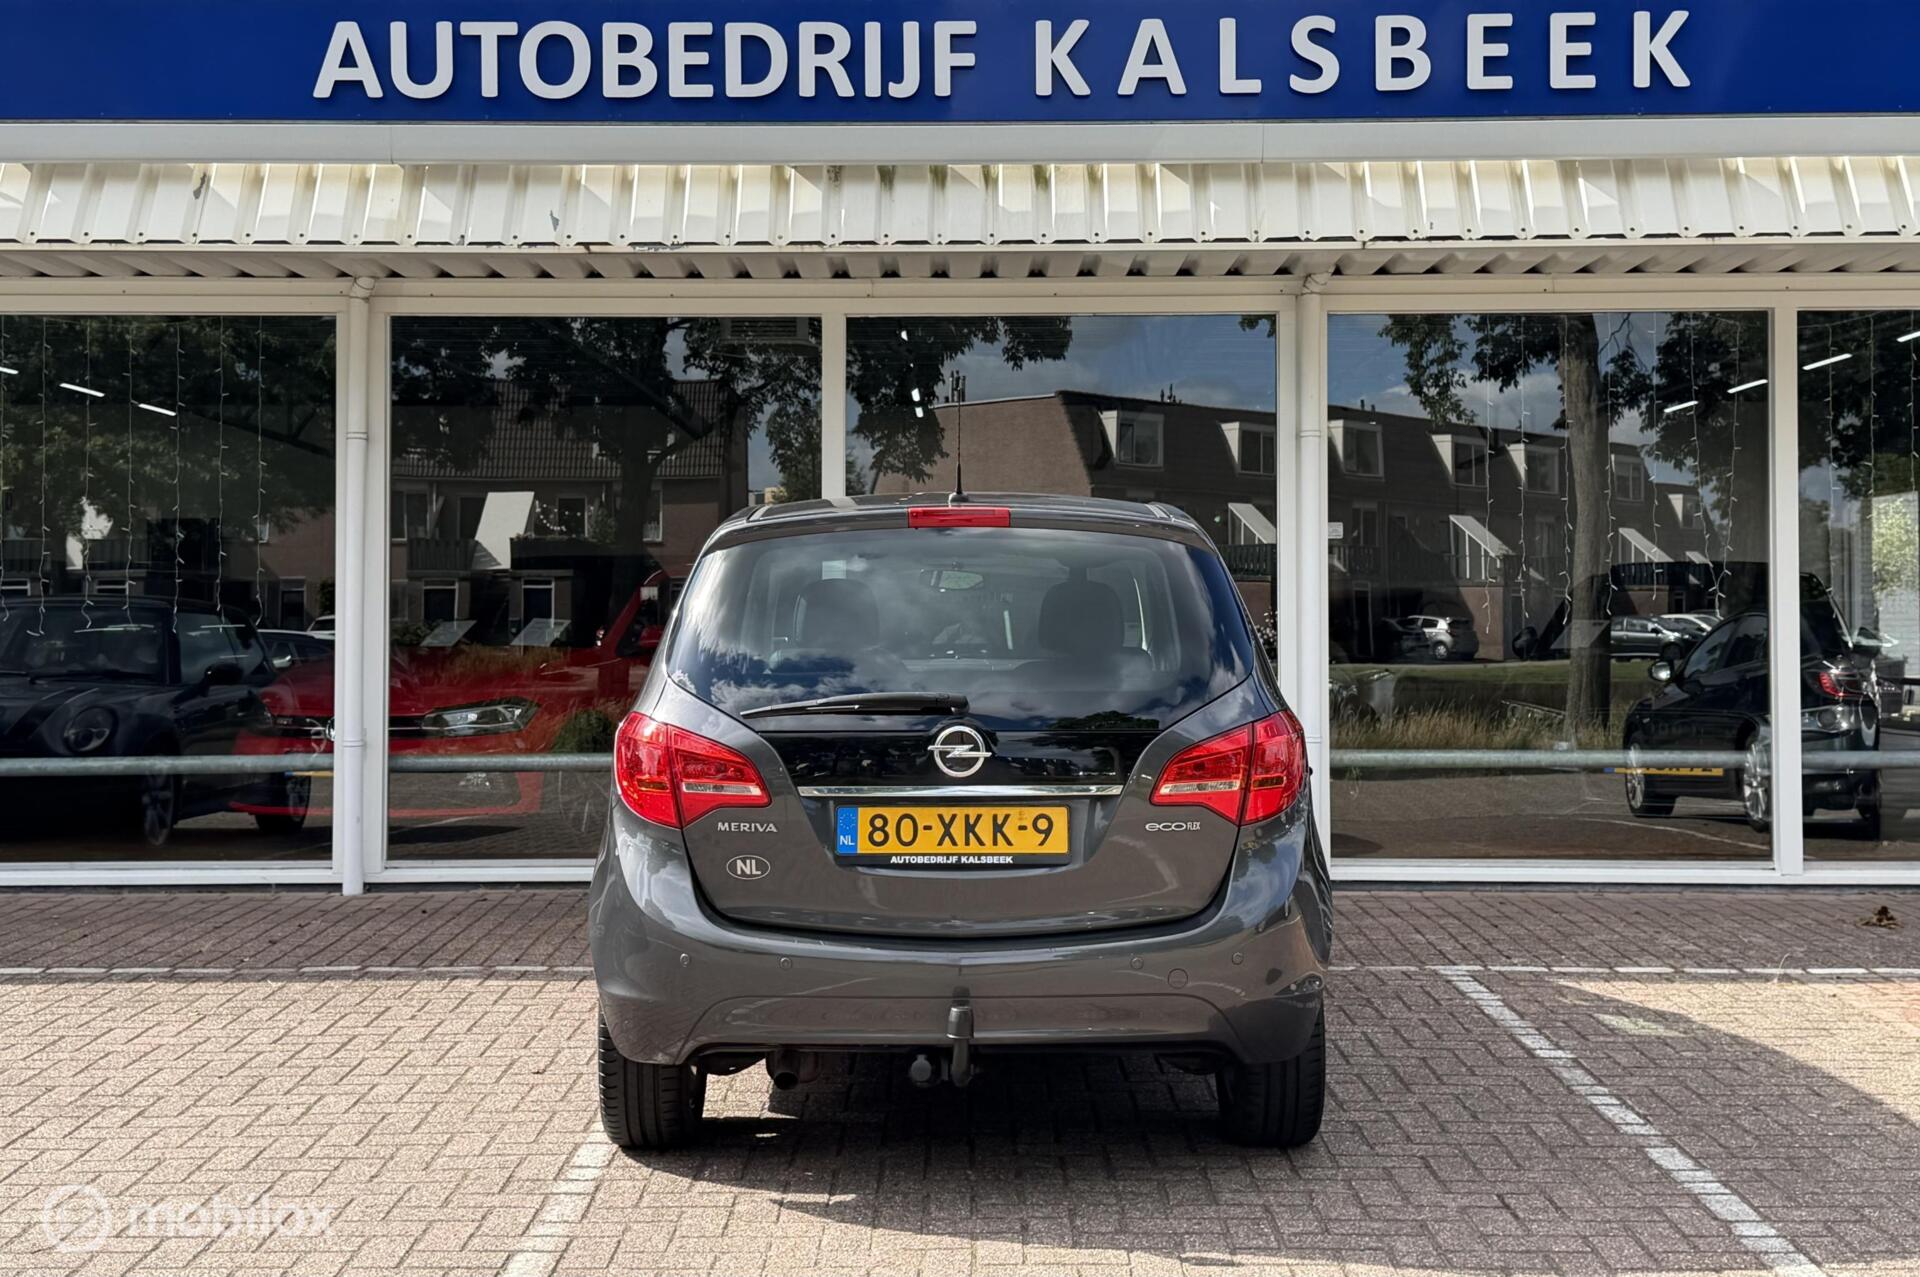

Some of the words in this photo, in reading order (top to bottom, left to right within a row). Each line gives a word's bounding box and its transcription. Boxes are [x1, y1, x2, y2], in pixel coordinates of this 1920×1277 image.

[313, 19, 977, 100] AUTOBEDRIJF
[1035, 9, 1691, 97] KALSBEEK
[717, 821, 778, 833] MERIVA
[867, 813, 1054, 848] 80-XKK-9
[839, 835, 855, 846] NL
[890, 855, 959, 864] AUTOBEDRIJF
[960, 855, 1013, 864] KALSBEEK
[736, 859, 761, 875] NL
